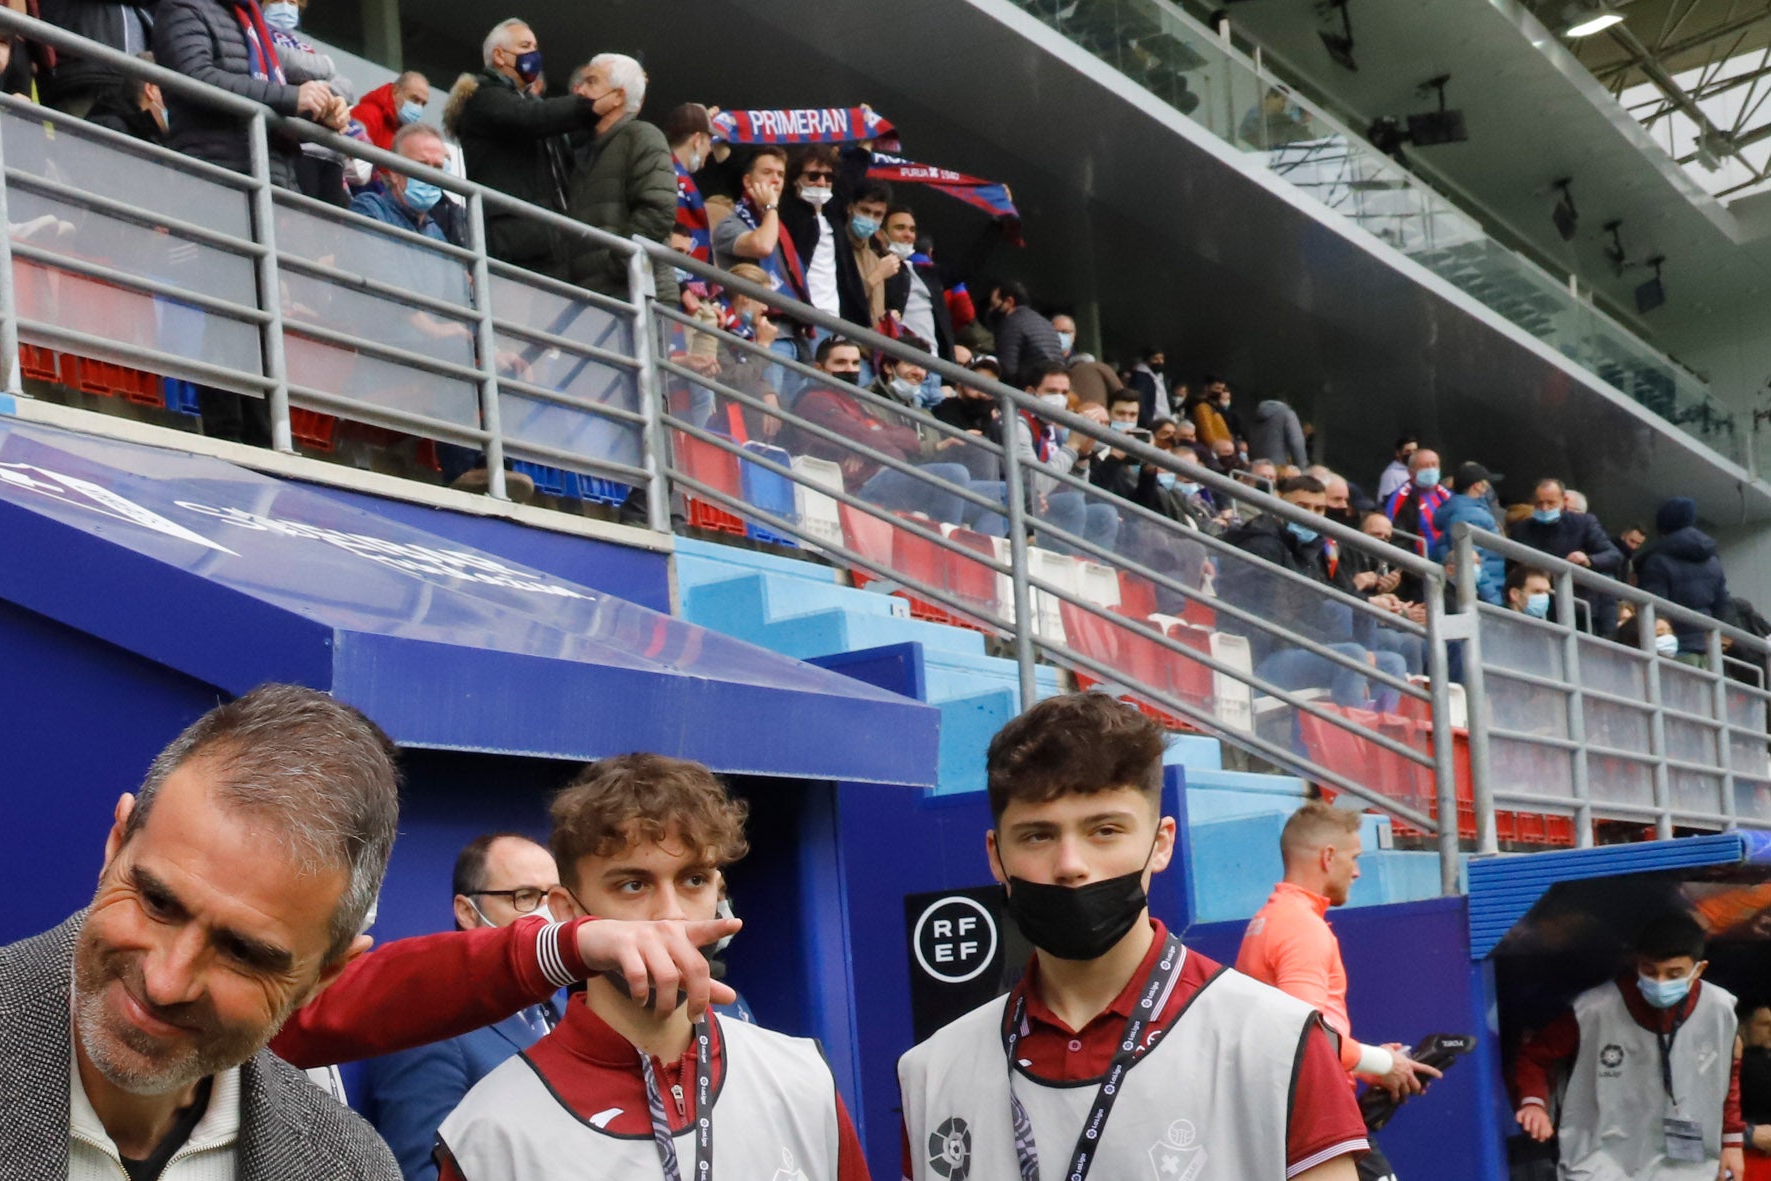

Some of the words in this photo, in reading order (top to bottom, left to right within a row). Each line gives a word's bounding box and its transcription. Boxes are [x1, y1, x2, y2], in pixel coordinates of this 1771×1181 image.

[747, 107, 849, 136] PRIMERAN
[1091, 1108, 1104, 1129] LaLiga
[1076, 1152, 1087, 1173] LaLiga
